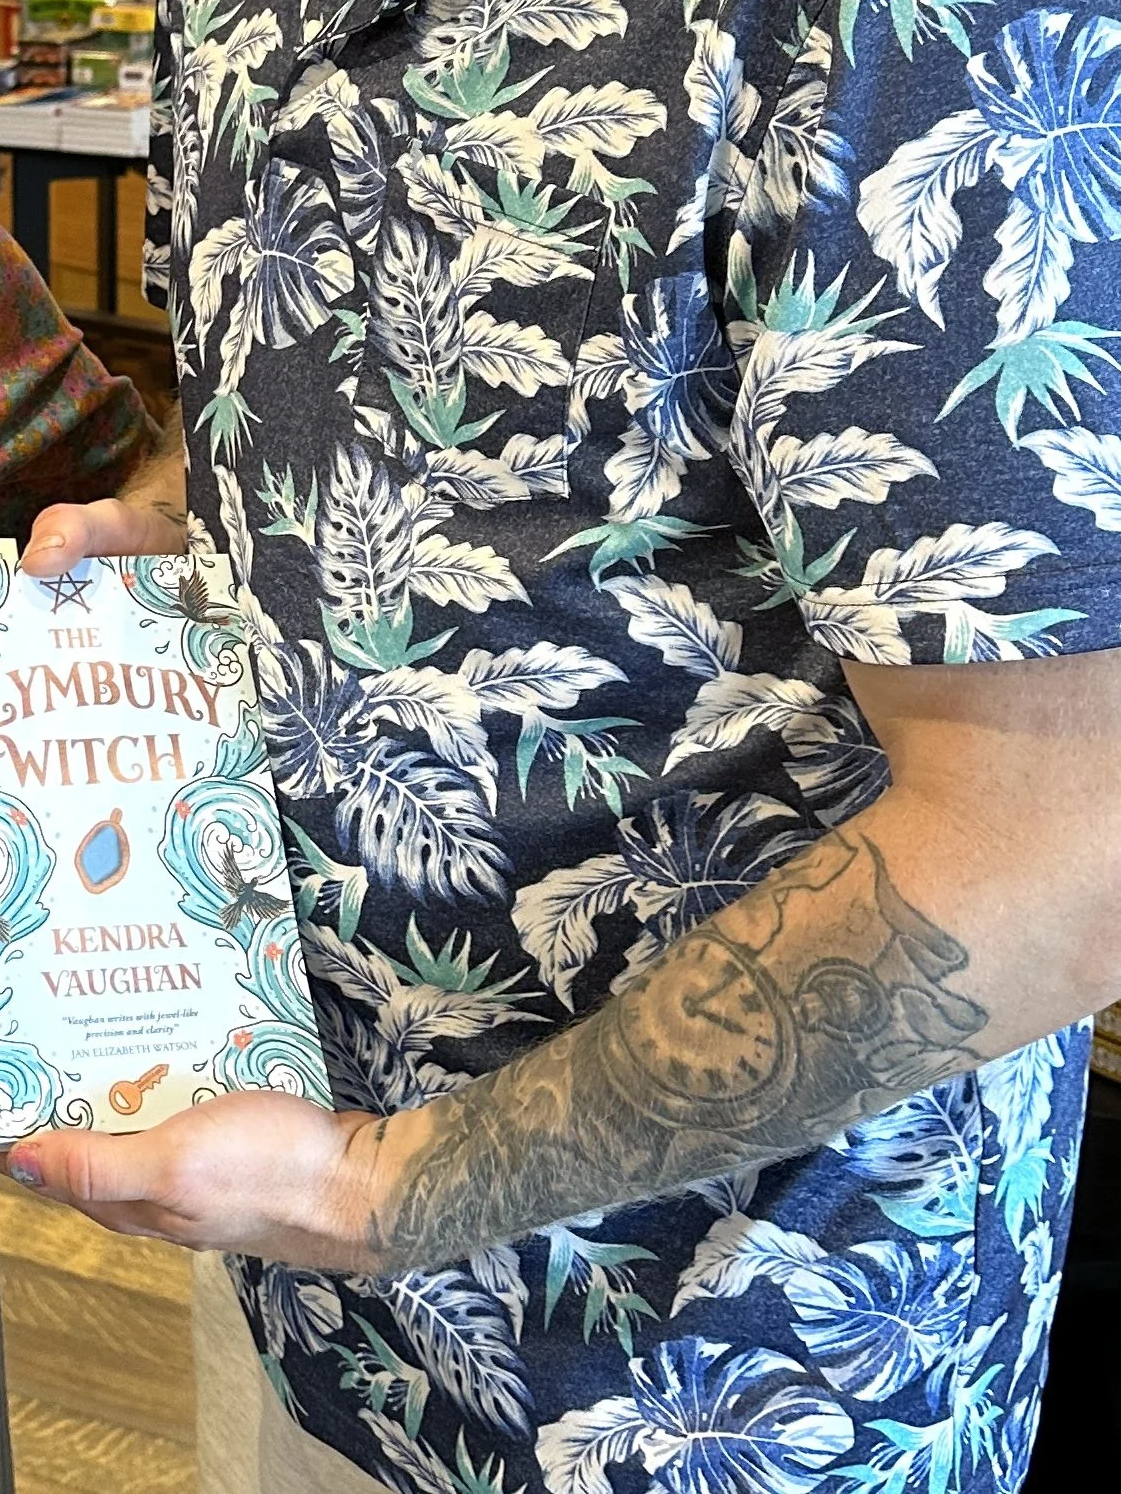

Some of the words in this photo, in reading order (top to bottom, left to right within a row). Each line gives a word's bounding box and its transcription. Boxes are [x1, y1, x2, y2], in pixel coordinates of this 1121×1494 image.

[48, 627, 103, 649] THE
[50, 922, 188, 955] KENDRA
[41, 962, 202, 998] VAUGHAN
[107, 1014, 133, 1024] writes
[135, 1011, 155, 1021] with
[156, 1008, 199, 1022] jewel-like
[85, 1029, 124, 1041] precision
[126, 1026, 144, 1036] and
[71, 1049, 90, 1060] JAN
[93, 1044, 151, 1057] ELIZABETH
[153, 1040, 198, 1052] WATSON
